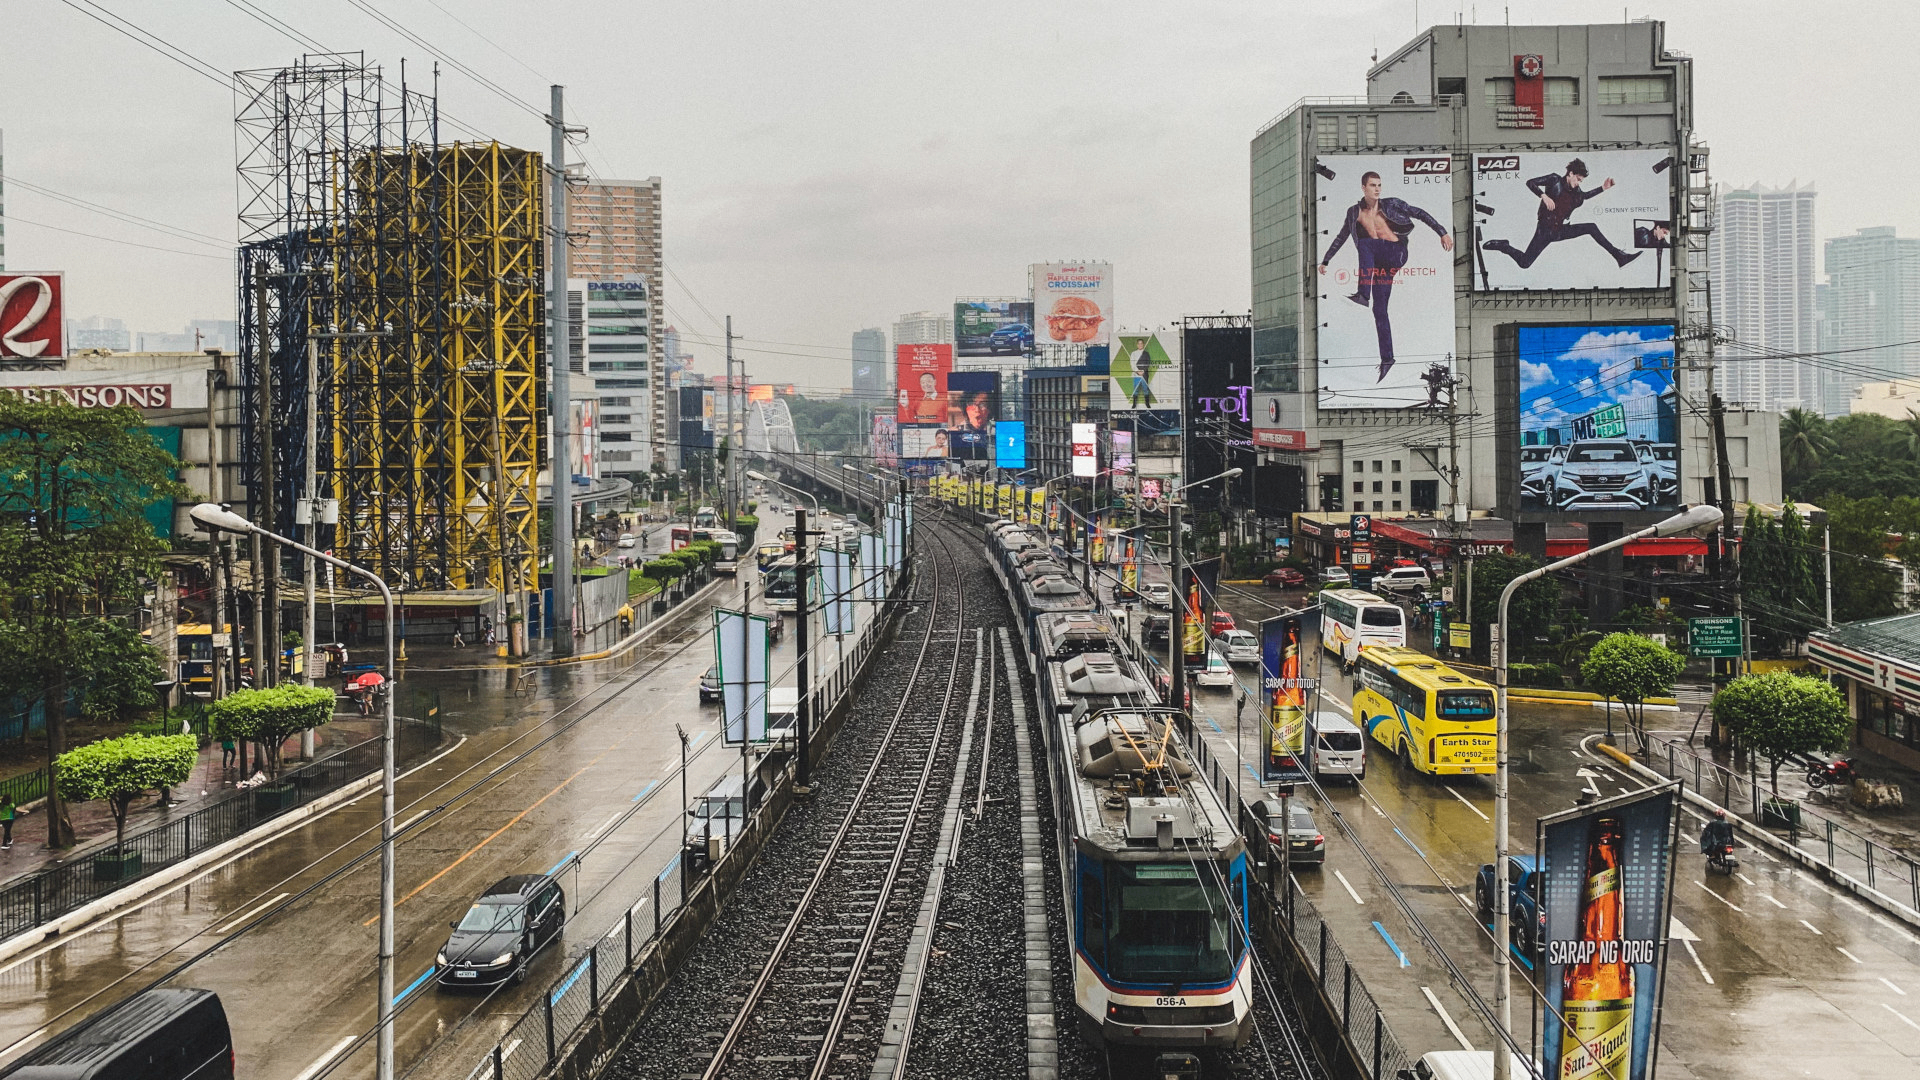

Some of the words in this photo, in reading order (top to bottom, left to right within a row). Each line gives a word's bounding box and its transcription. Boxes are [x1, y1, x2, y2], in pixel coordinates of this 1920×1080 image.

[1406, 161, 1448, 171] JAG
[1480, 159, 1517, 169] JAG
[1404, 176, 1451, 184] BLACK
[1478, 172, 1519, 180] BLACK
[1354, 268, 1386, 277] ULTRA
[1390, 268, 1436, 276] STRETCH
[588, 282, 643, 291] EMERSON
[1266, 678, 1285, 688] SARAP
[1287, 678, 1295, 688] NG
[1296, 679, 1314, 688] TOTOO
[1550, 940, 1595, 964] SARAP
[1600, 942, 1617, 963] NG
[1624, 940, 1653, 963] ORIG
[1157, 998, 1186, 1006] 056-A
[1564, 1056, 1585, 1078] San
[1587, 1022, 1628, 1066] Miguel
